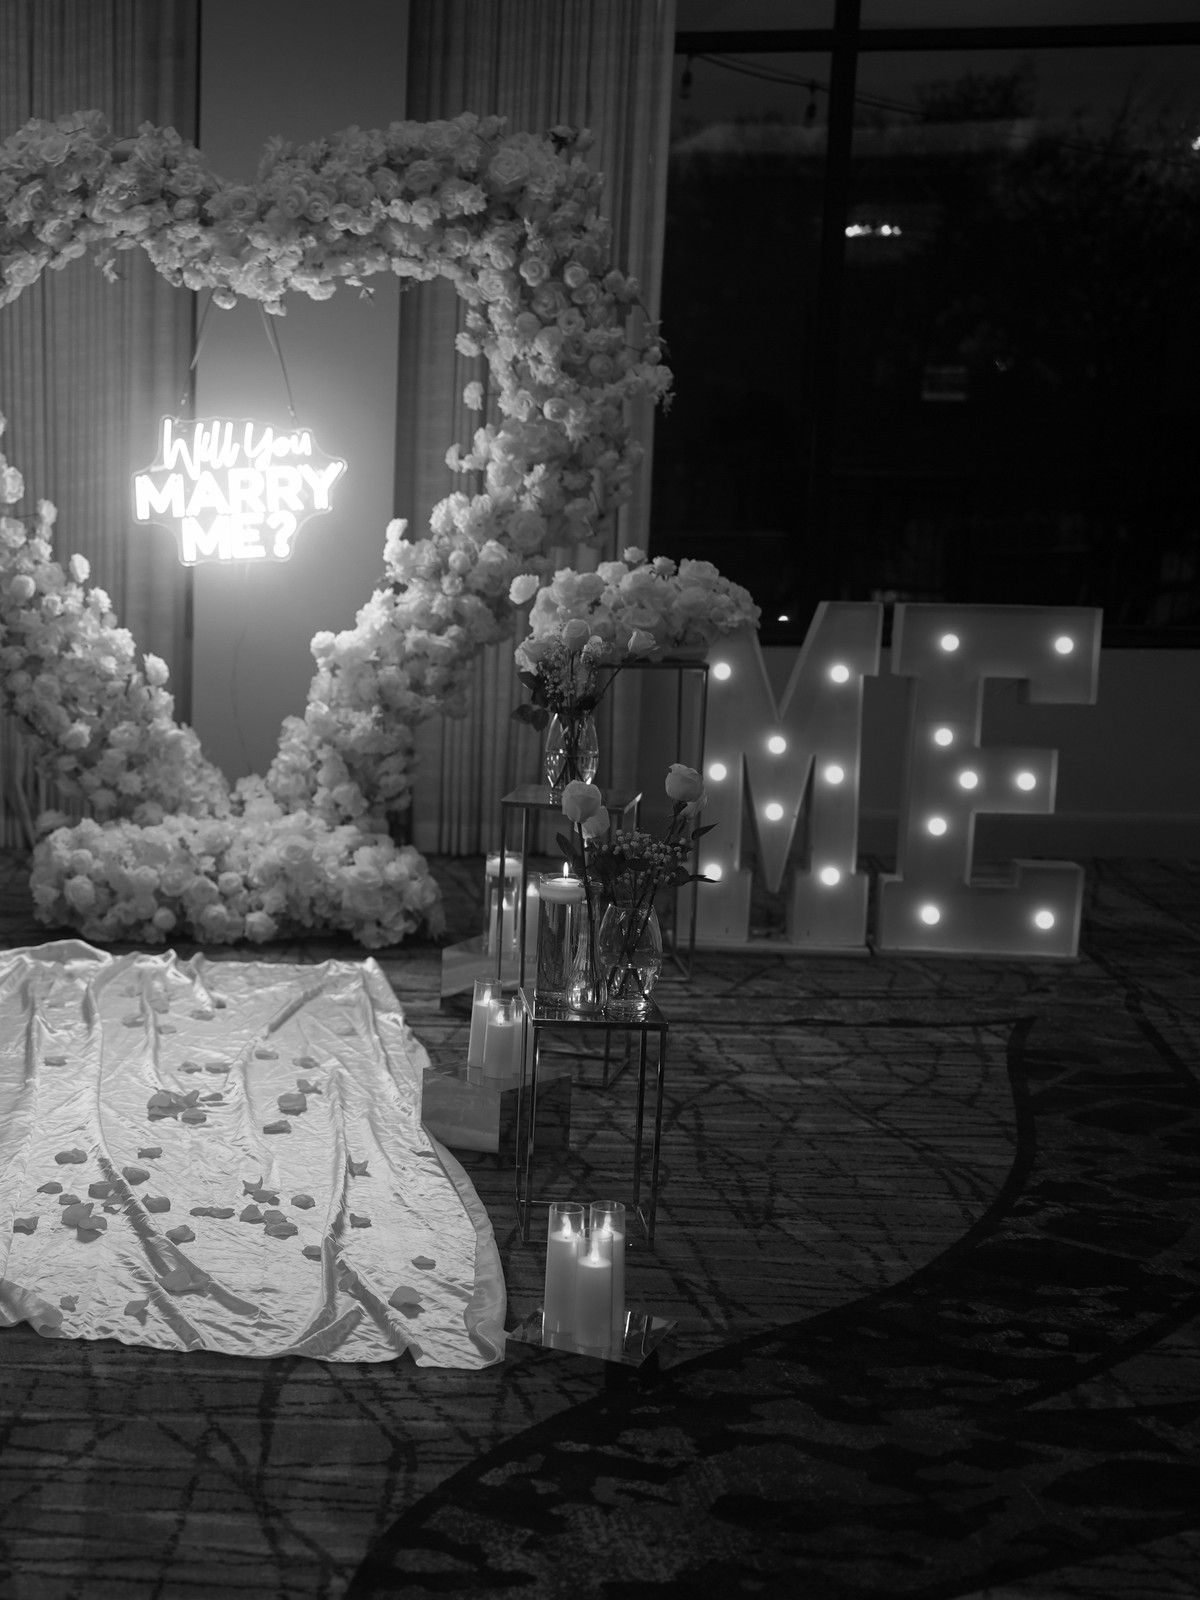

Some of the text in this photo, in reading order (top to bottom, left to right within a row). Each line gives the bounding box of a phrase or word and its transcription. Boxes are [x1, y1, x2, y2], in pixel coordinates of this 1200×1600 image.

[163, 418, 240, 480] Will
[135, 461, 343, 519] MARRY
[182, 510, 297, 561] ME?
[677, 601, 1102, 956] ME
